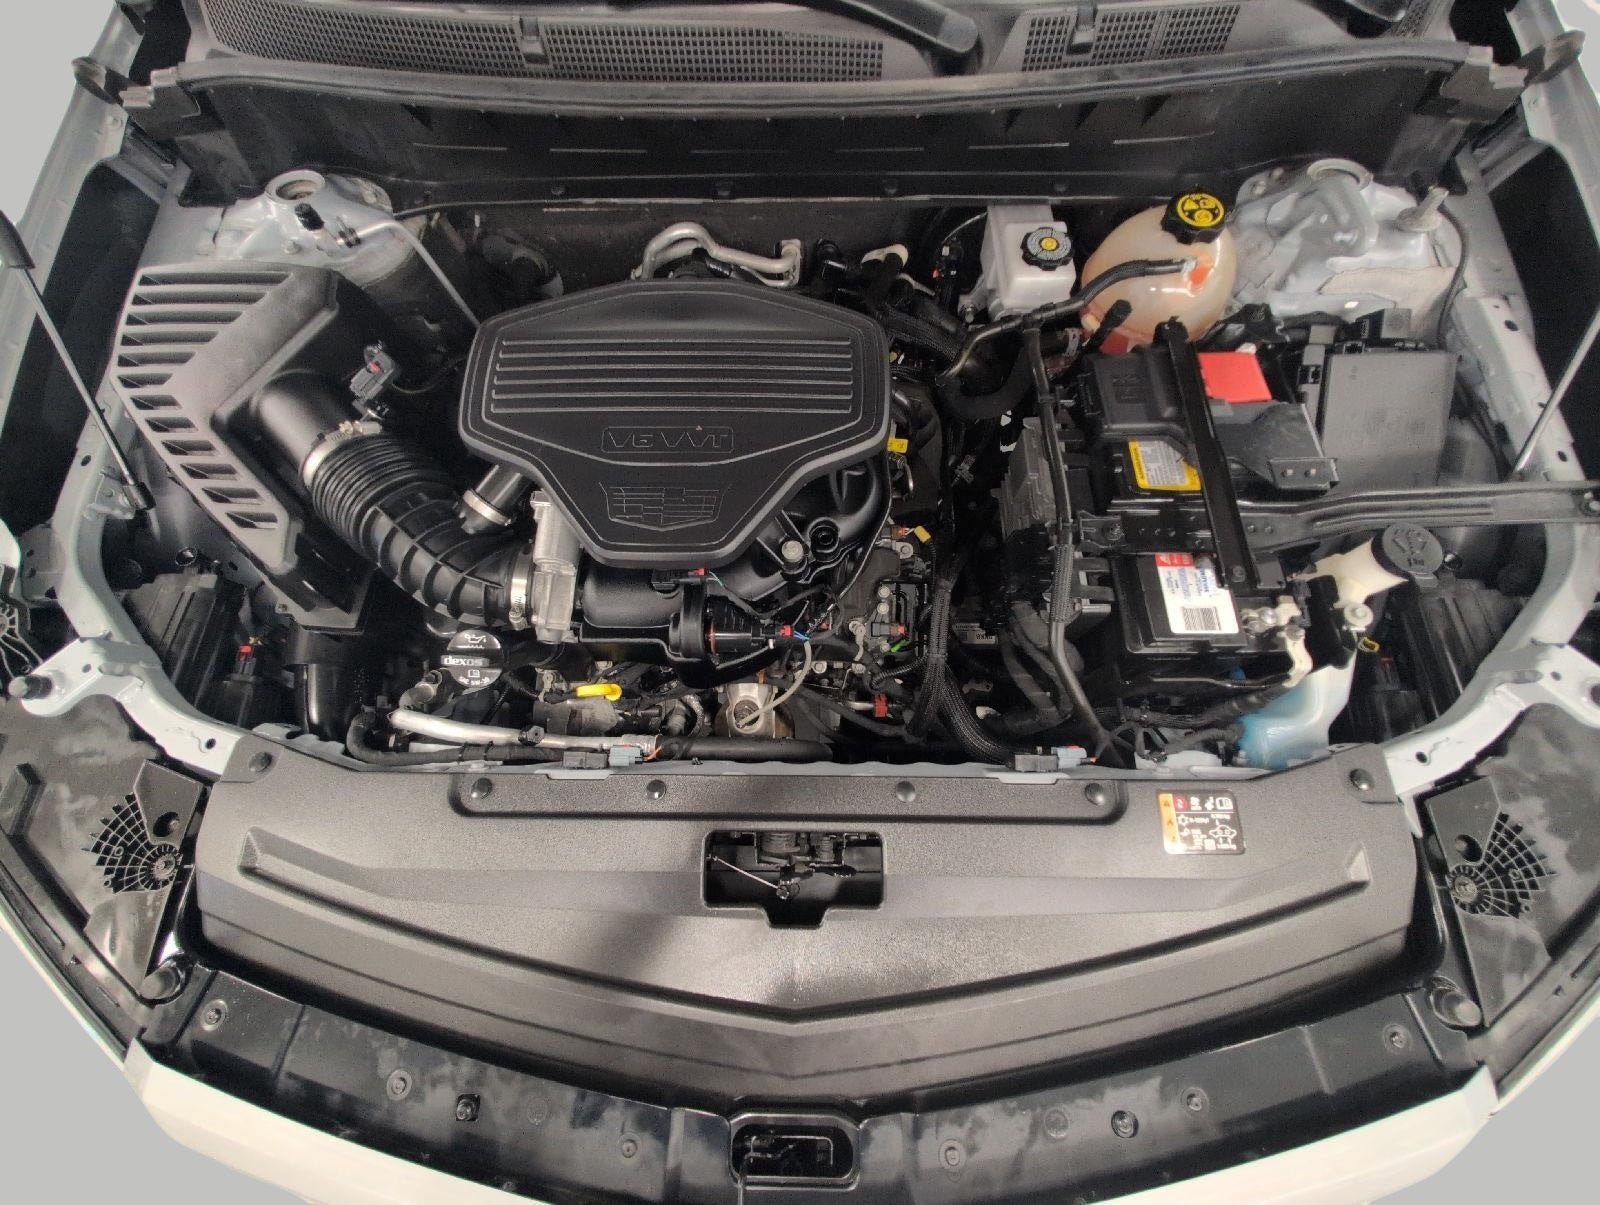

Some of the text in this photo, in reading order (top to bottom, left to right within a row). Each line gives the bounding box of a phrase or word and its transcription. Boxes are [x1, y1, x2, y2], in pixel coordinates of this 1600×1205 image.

[608, 431, 729, 448] V6 VVT
[444, 655, 483, 666] dexos
